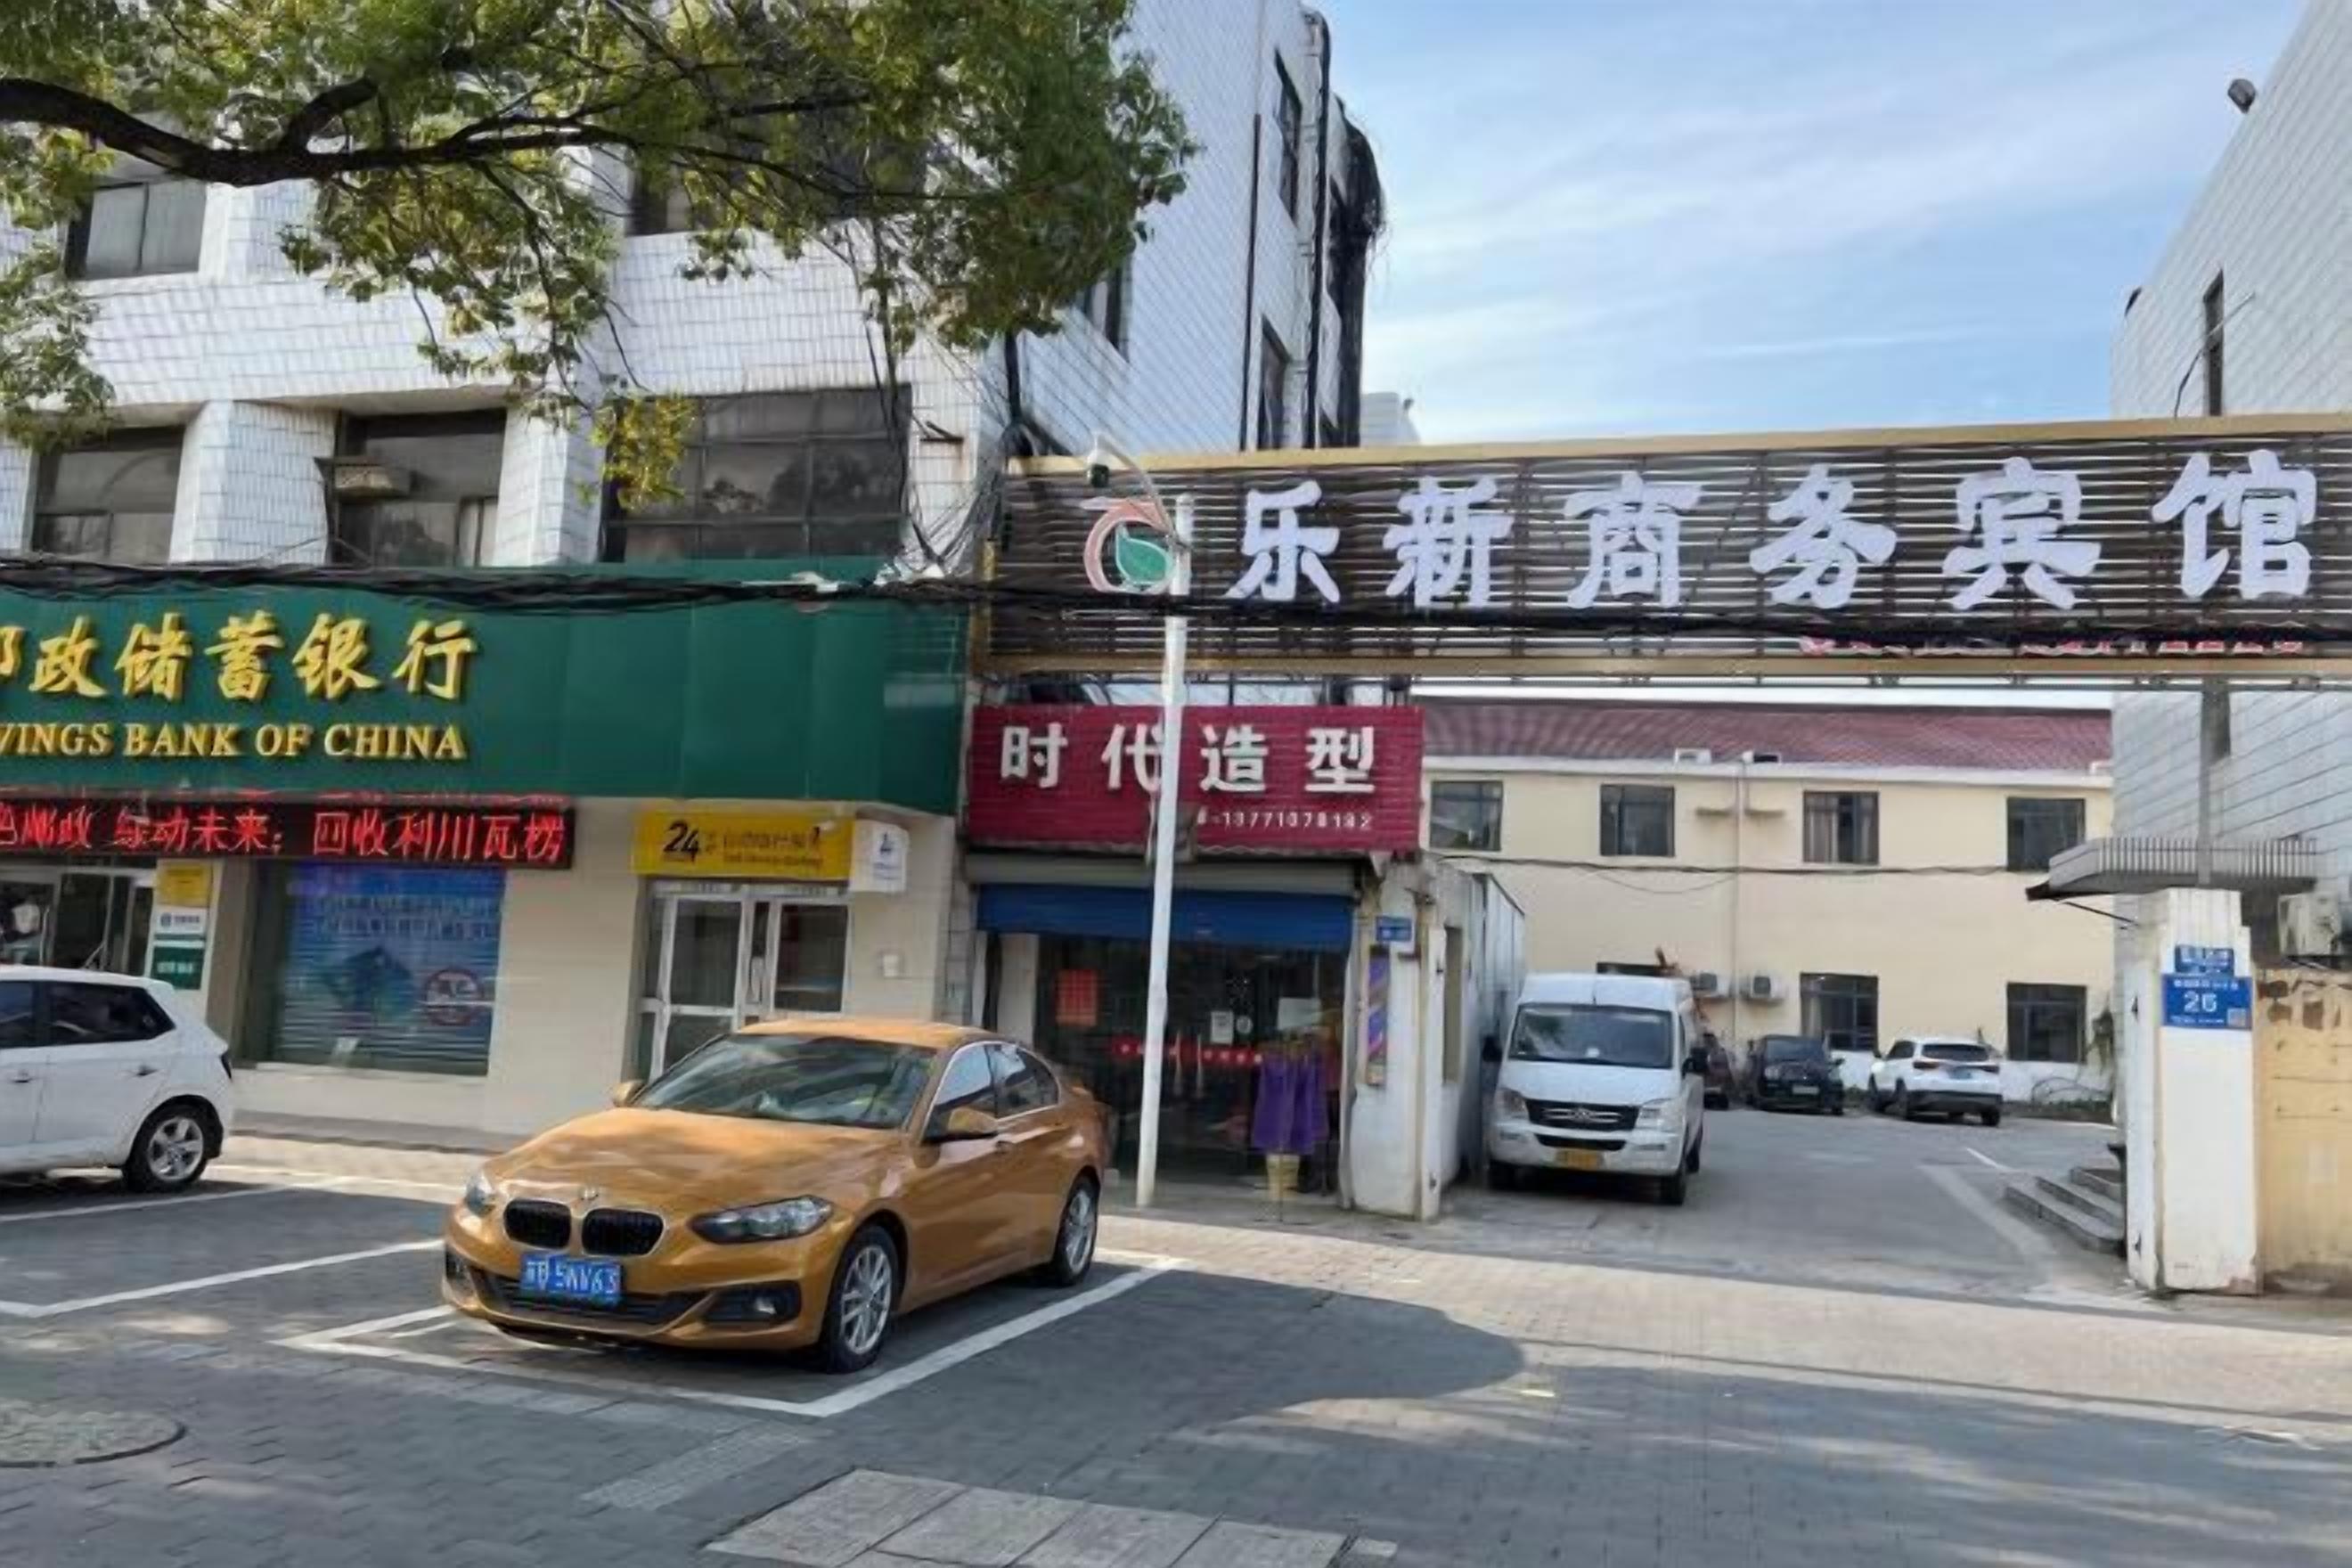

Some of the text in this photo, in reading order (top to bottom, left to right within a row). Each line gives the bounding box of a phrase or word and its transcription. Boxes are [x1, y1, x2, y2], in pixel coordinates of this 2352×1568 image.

[1224, 449, 2317, 609] 乐新商务宾馆
[123, 723, 242, 758] BANK
[255, 723, 312, 757] OF
[323, 723, 469, 760] CHINA
[1000, 722, 1376, 794] 时代造型
